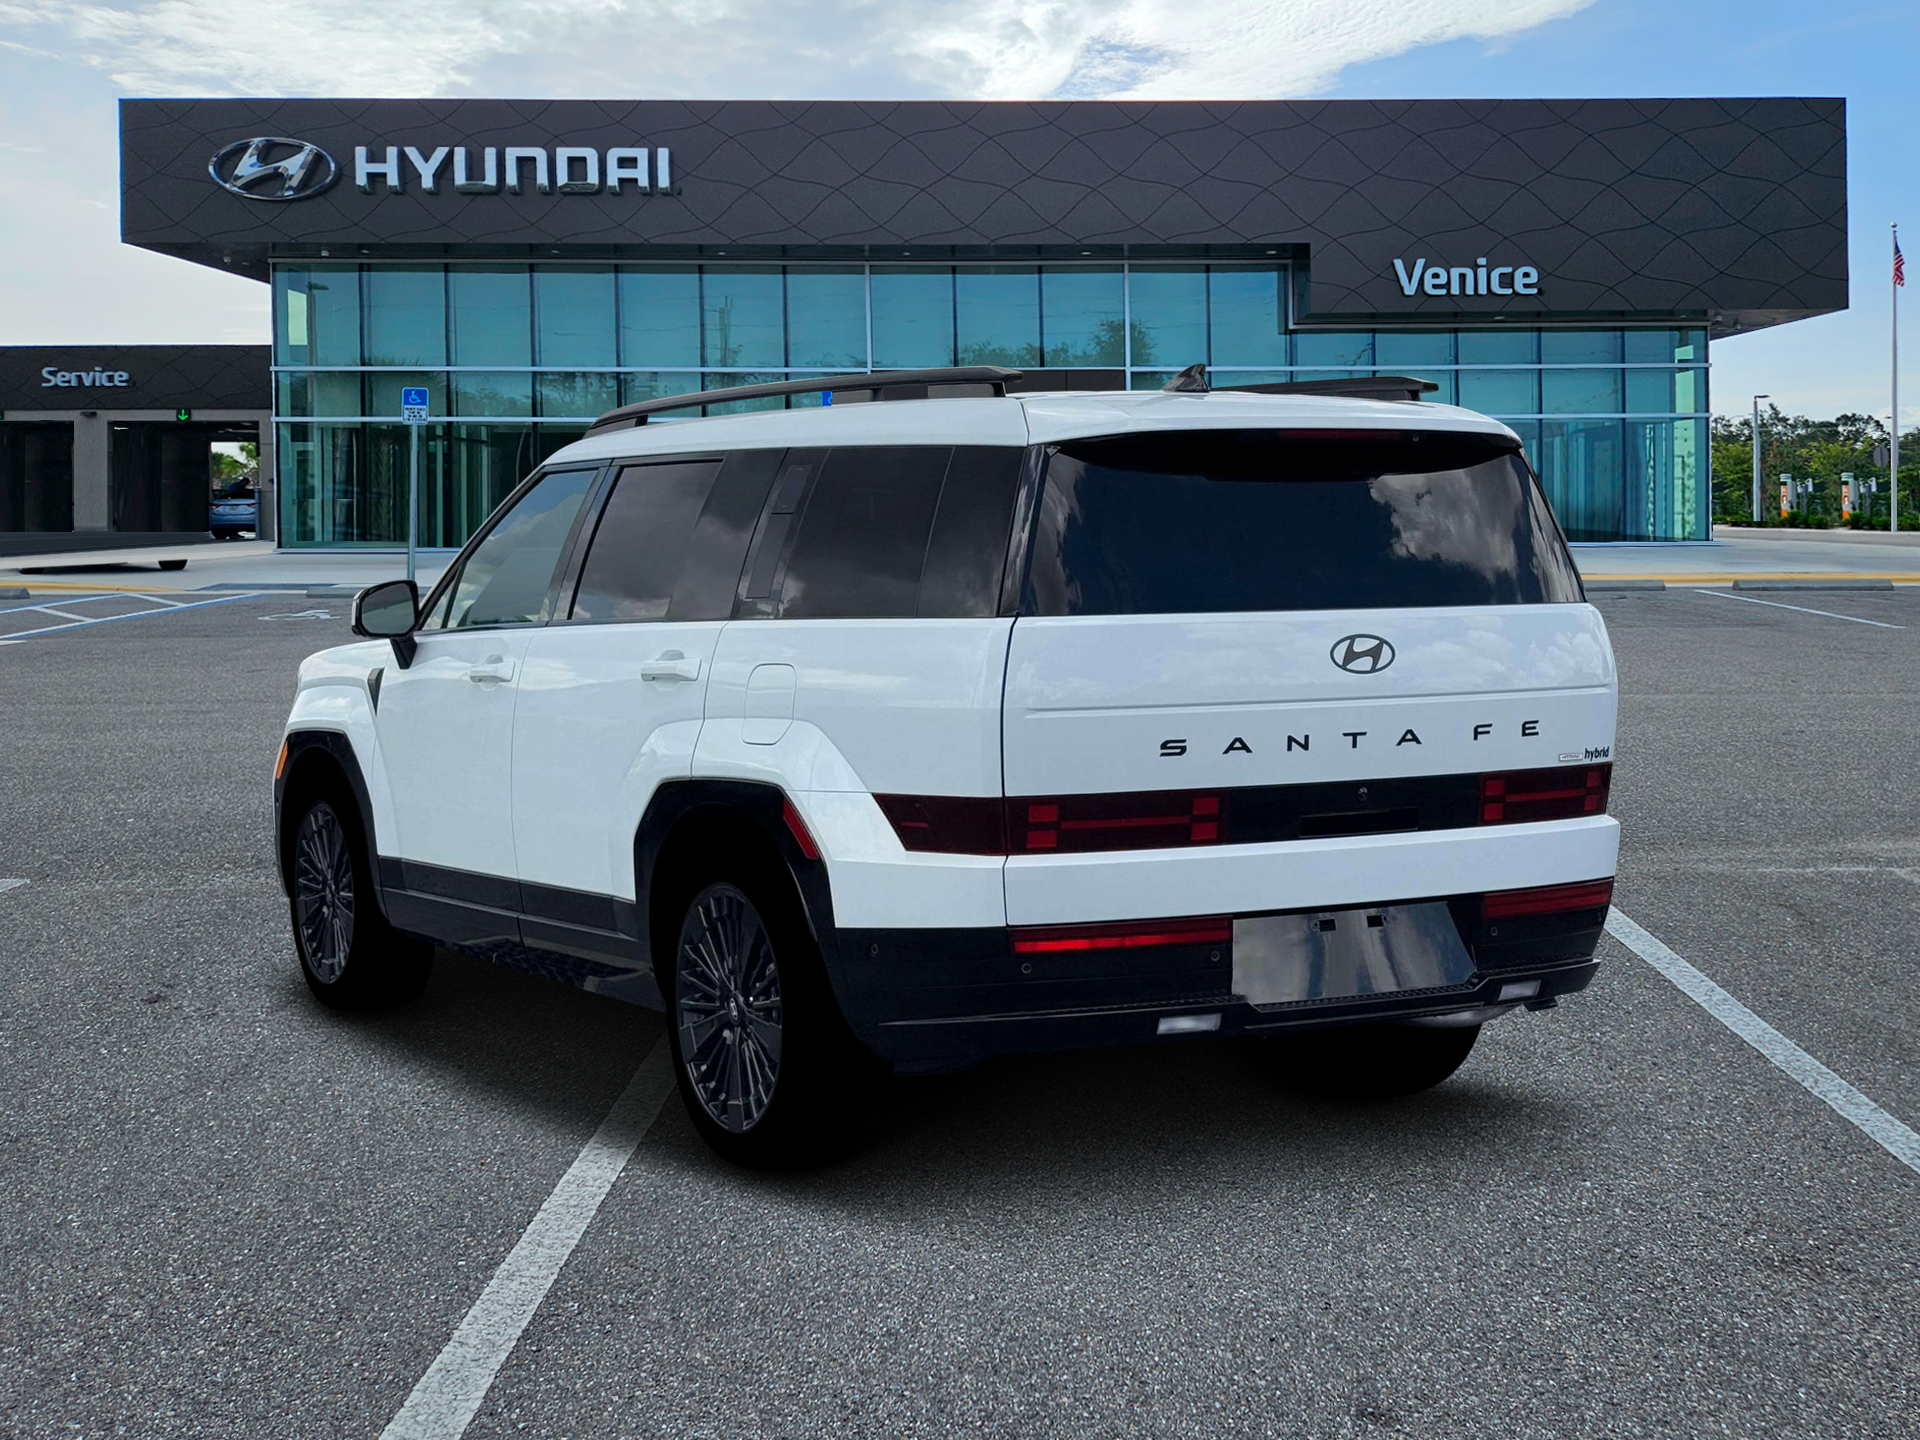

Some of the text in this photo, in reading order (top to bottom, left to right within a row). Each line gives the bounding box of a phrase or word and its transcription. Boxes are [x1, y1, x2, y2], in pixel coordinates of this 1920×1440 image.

[354, 146, 672, 194] HYUNDAI
[1393, 257, 1539, 296] Venice
[41, 366, 130, 387] Service
[1159, 719, 1540, 757] SANTA FE
[1584, 746, 1610, 762] hybrid
